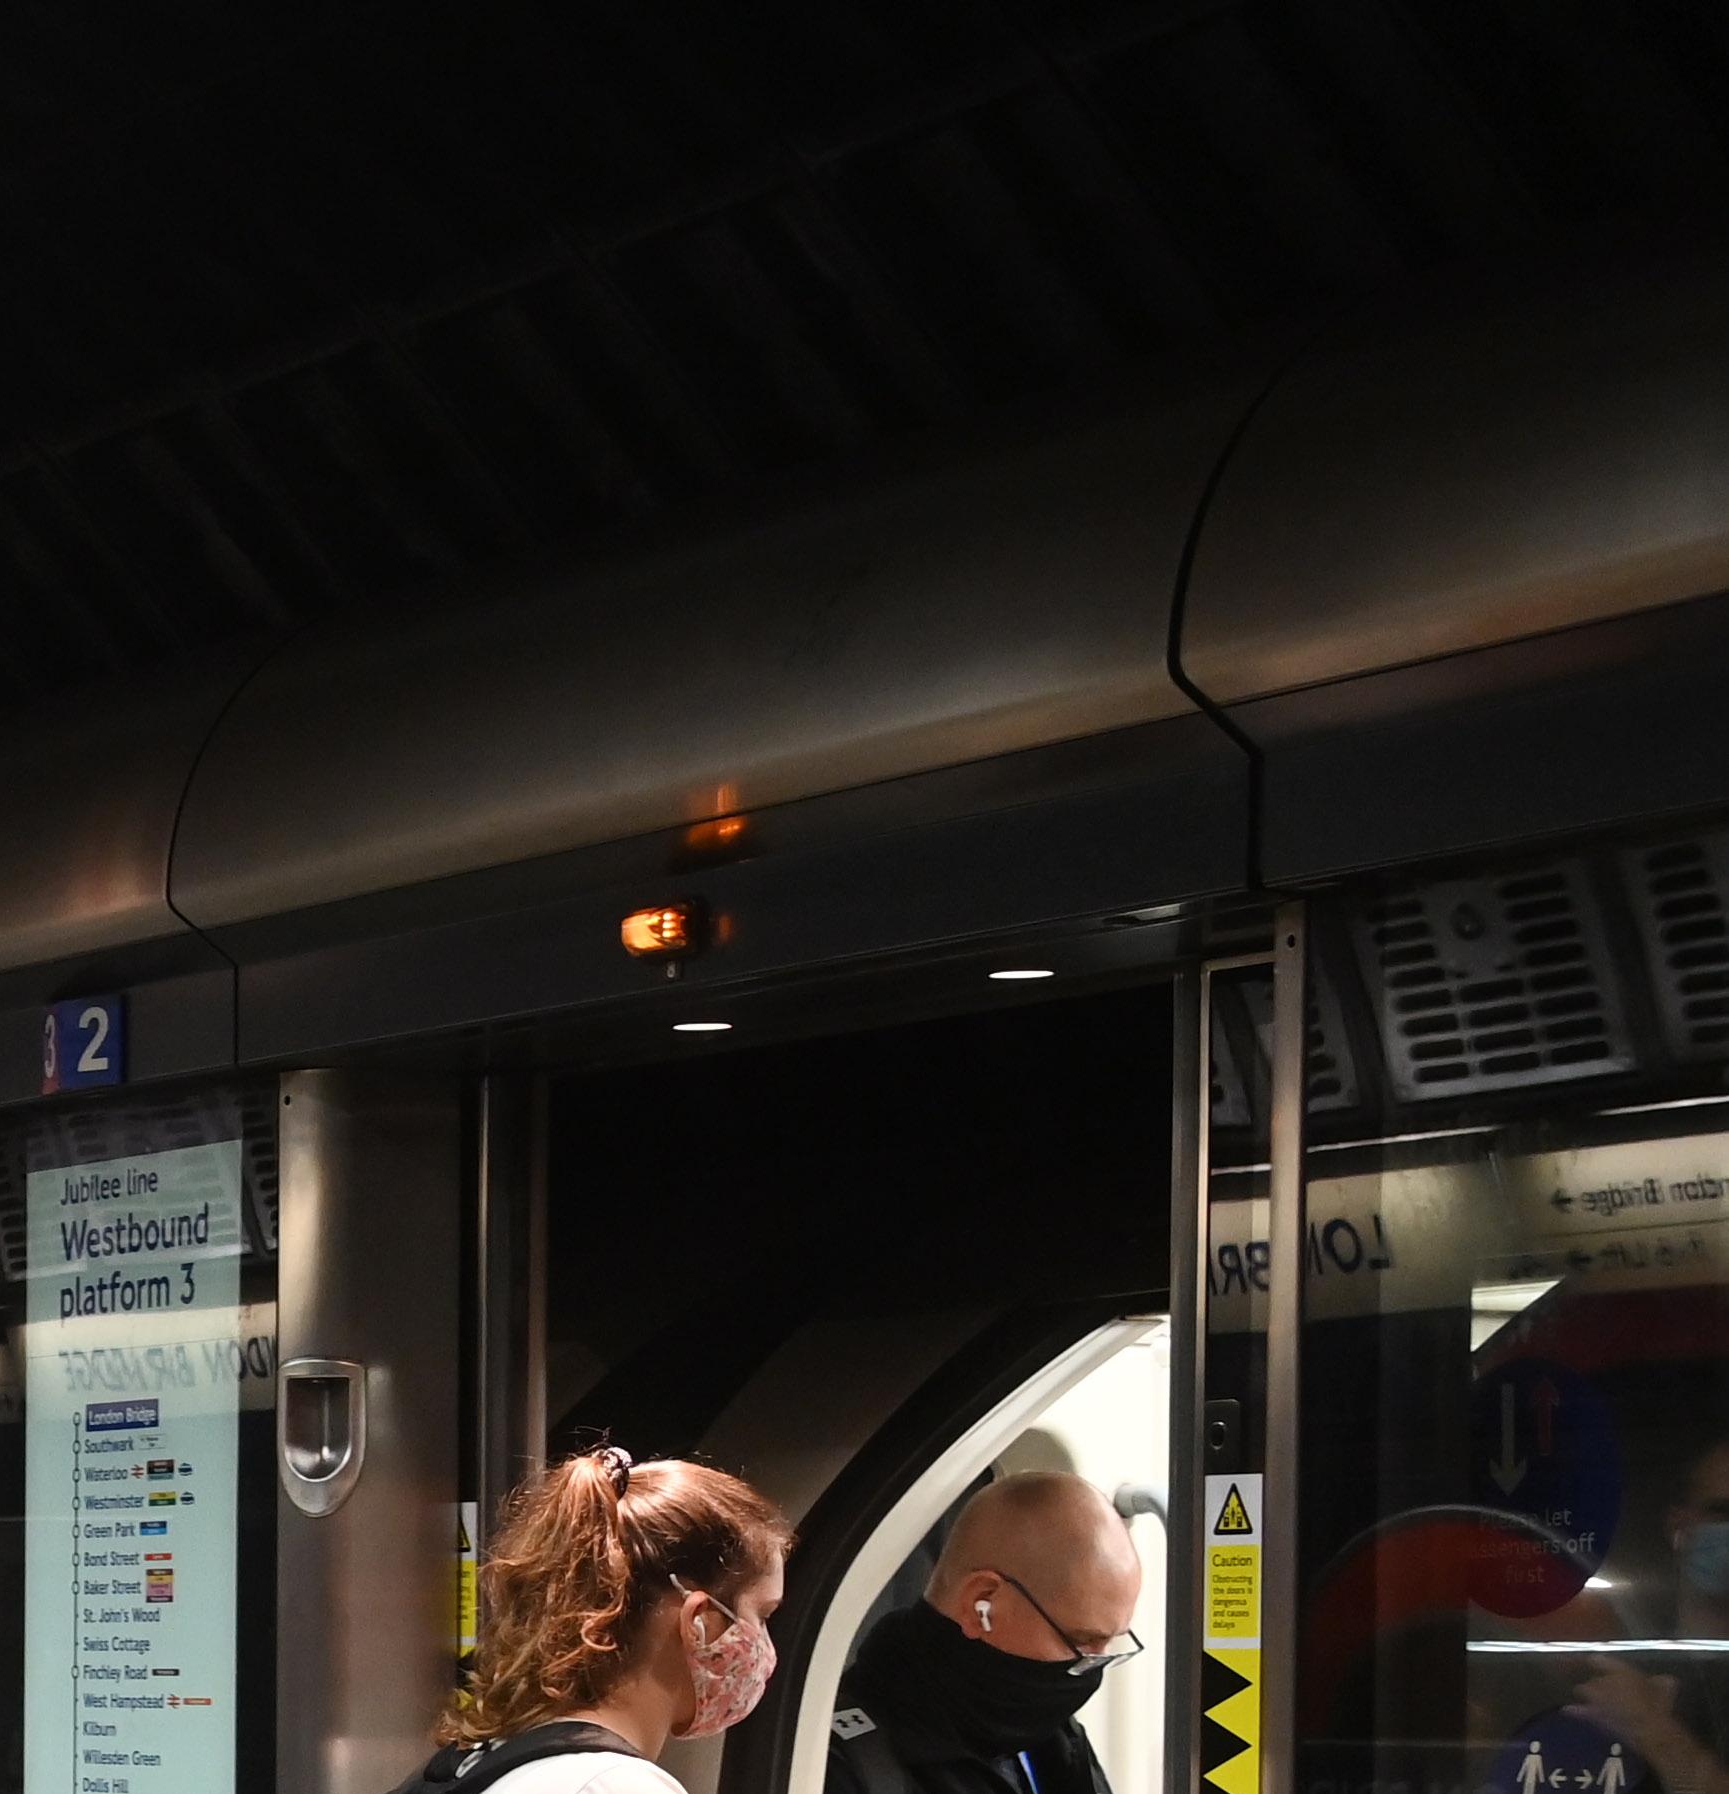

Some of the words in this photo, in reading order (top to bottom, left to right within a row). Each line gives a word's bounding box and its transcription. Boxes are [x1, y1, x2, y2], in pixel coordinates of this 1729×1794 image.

[44, 1015, 56, 1078] 3
[77, 1006, 109, 1072] 2
[61, 1174, 121, 1206] Jubilee
[127, 1168, 158, 1196] line
[61, 1201, 209, 1261] Westbound
[60, 1271, 170, 1328] platform
[179, 1262, 196, 1305] 3
[89, 1409, 123, 1426] London
[126, 1406, 157, 1426] Bridge
[84, 1437, 134, 1454] Southwark
[84, 1466, 128, 1482] Waterloo
[84, 1494, 144, 1510] Westminster
[83, 1523, 112, 1538] Green
[114, 1522, 135, 1537] Park
[1566, 1532, 1596, 1554] off
[83, 1552, 108, 1566] Bond
[110, 1552, 140, 1566] Street
[1213, 1554, 1253, 1567] Caution
[83, 1580, 109, 1595] Baker
[110, 1580, 142, 1595] Street
[83, 1608, 96, 1623] St.
[99, 1608, 130, 1623] John's
[132, 1608, 160, 1623] Wood
[83, 1637, 109, 1652] Swiss
[112, 1636, 150, 1655] Cottage
[83, 1665, 121, 1683] Finchley
[124, 1665, 148, 1680] Road
[83, 1693, 107, 1708] West
[110, 1694, 164, 1712] Hampstead
[83, 1721, 116, 1736] Kilburn
[83, 1750, 130, 1766] Willesden
[132, 1751, 161, 1766] Green
[82, 1778, 109, 1793] Dollis
[112, 1778, 129, 1794] Hill
